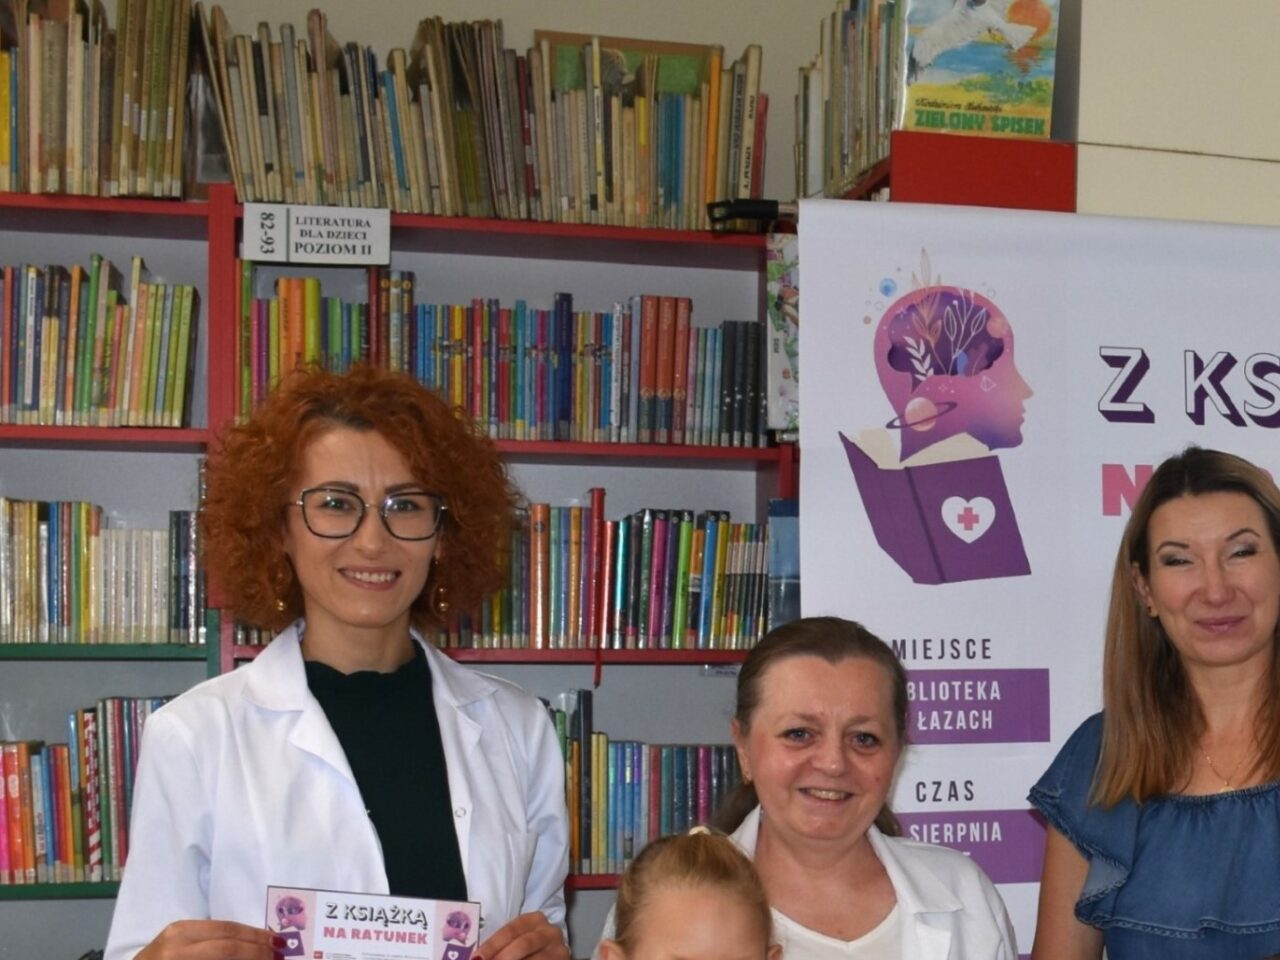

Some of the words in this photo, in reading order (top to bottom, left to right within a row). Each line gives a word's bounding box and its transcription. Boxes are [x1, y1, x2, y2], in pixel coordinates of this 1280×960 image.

[914, 108, 985, 131] ZIELONY
[991, 113, 1046, 135] SPISEK
[260, 211, 275, 254] 82-93
[295, 216, 372, 228] LITERATURA
[300, 228, 324, 239] DLA
[326, 229, 367, 240] DZIECI
[295, 241, 357, 255] POZIOM
[1098, 345, 1156, 424] Z
[1101, 463, 1152, 517] N
[892, 638, 992, 660] MIEJSCE
[907, 681, 1001, 702] BLIOTEKA
[917, 709, 993, 731] ŁAZACH
[915, 780, 975, 803] CZAS
[909, 821, 1002, 844] SIERPNIA
[325, 902, 339, 919] Z
[343, 902, 428, 930] KSIĄŻKĄ
[323, 927, 347, 939] NA
[351, 928, 428, 945] RATUNEK
